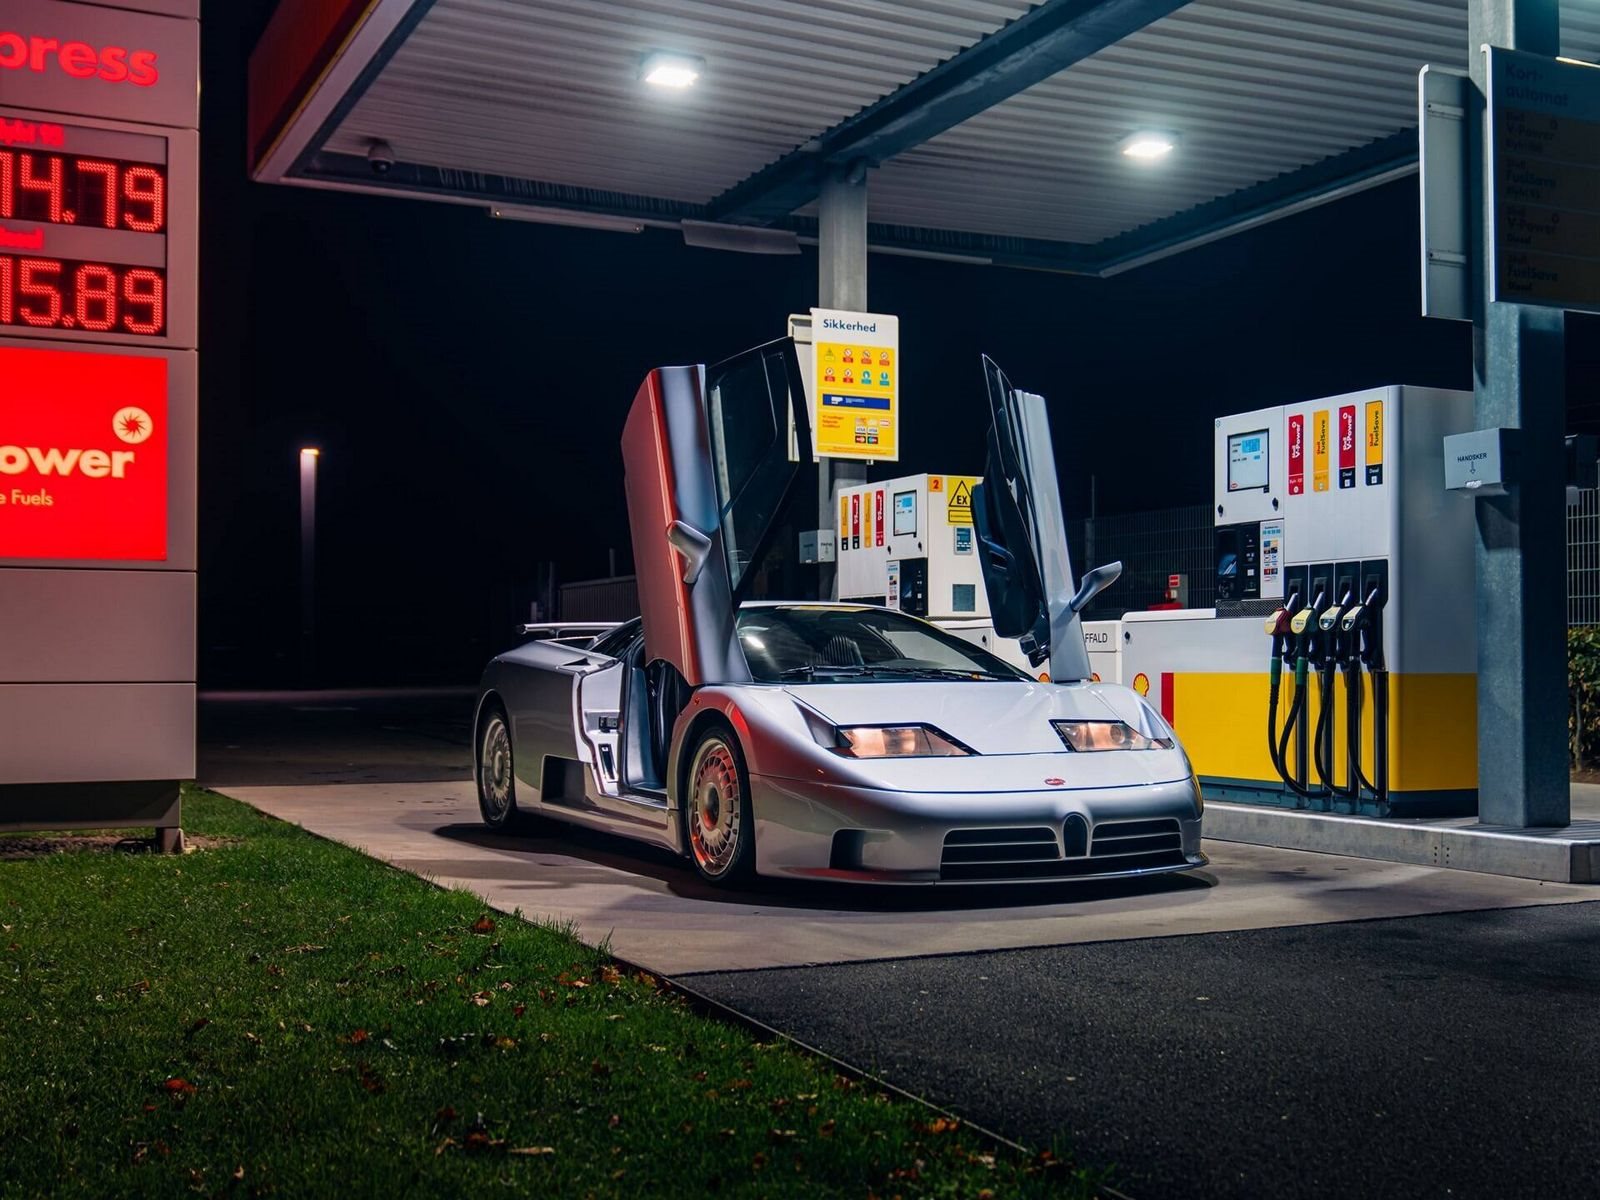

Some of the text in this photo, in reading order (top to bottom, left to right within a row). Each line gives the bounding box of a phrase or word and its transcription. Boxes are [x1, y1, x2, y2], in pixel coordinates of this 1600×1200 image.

[0, 152, 163, 233] 14.79
[0, 257, 163, 334] 15.89
[823, 318, 876, 333] Sikkerhed
[0, 445, 135, 479] ower
[1457, 452, 1488, 462] HANDSKER
[933, 479, 939, 489] 2
[11, 488, 54, 506] Fuels
[956, 495, 968, 505] EX
